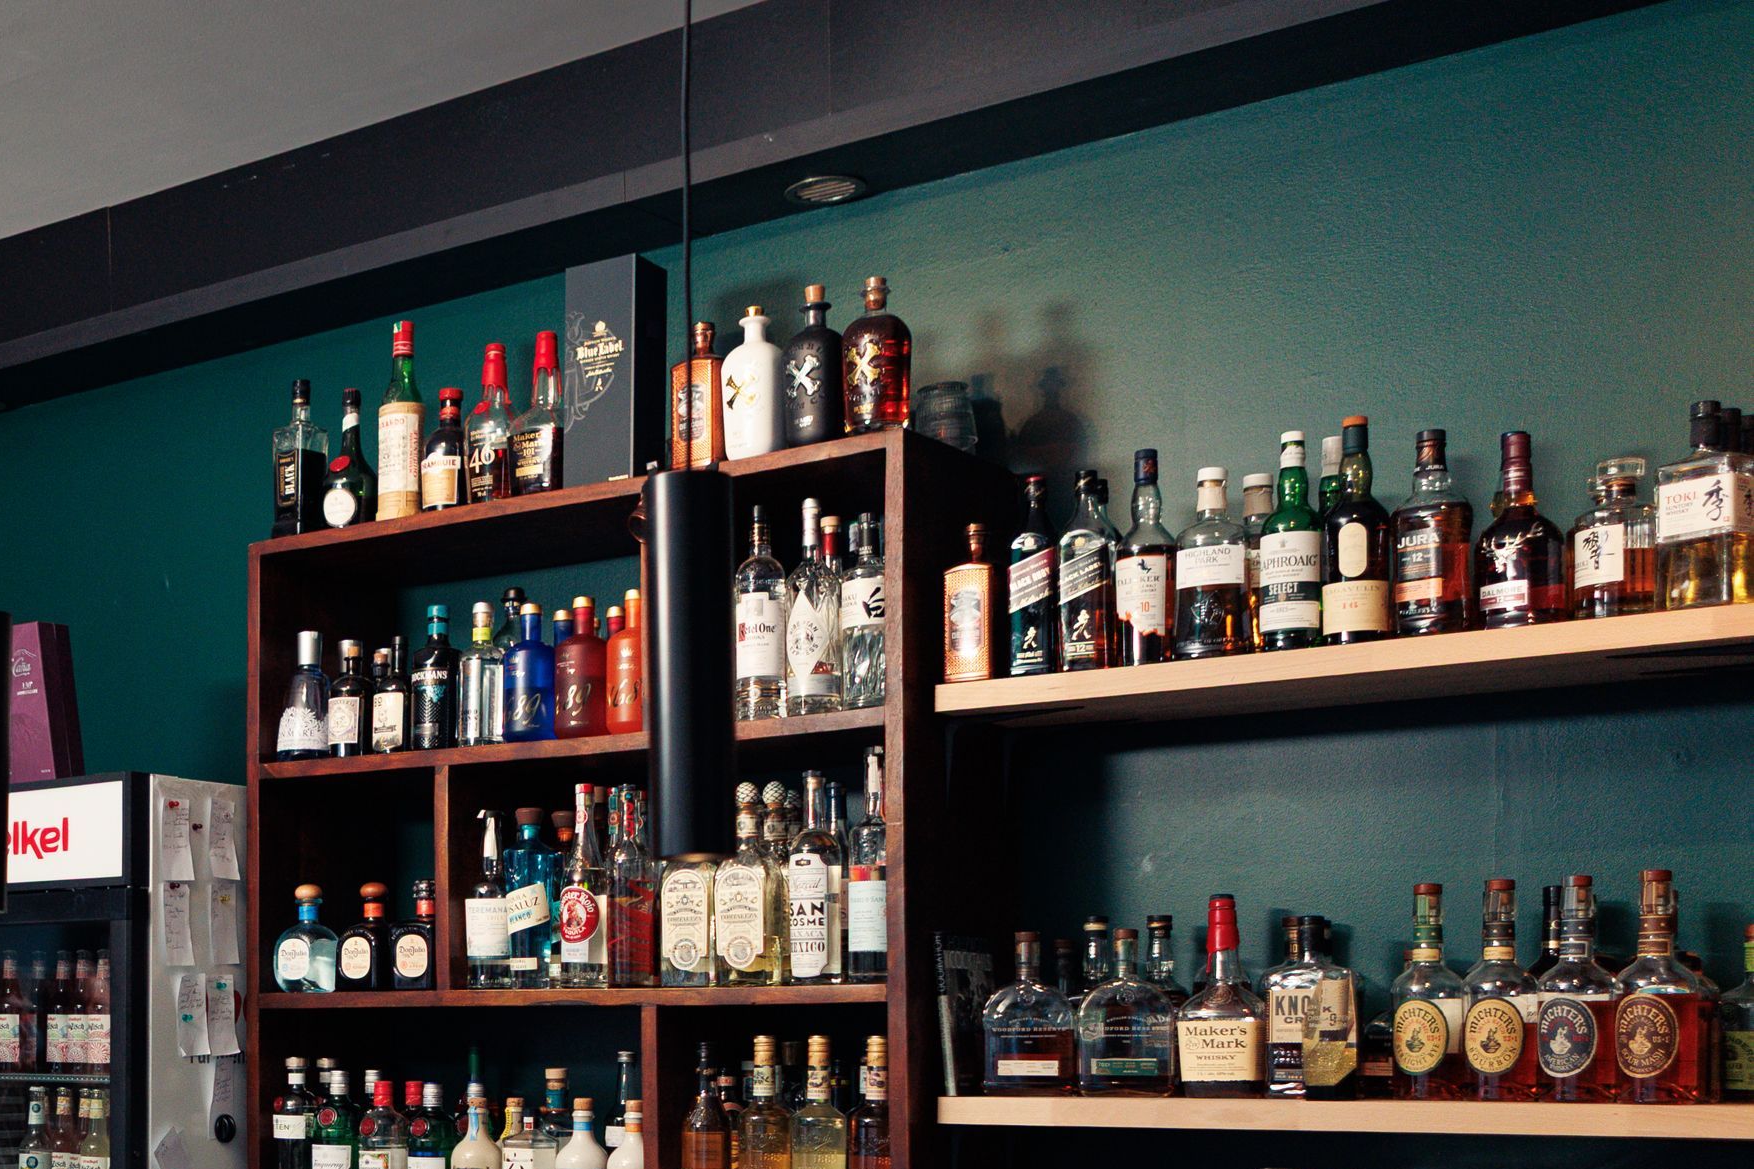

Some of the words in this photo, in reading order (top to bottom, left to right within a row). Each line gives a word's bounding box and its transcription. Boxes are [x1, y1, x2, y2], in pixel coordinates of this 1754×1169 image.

[576, 346, 598, 360] Blue
[598, 339, 624, 357] Label
[423, 459, 456, 469] RAMBUIE
[469, 441, 496, 474] 46
[284, 463, 295, 495] BLACK
[1665, 491, 1697, 505] TOKI
[1397, 532, 1440, 549] JURA
[1184, 547, 1231, 559] HIGHLAND
[1194, 556, 1219, 564] PARK
[1412, 552, 1423, 563] 12
[1268, 582, 1299, 595] SELECT
[1482, 585, 1523, 597] DALMORE
[1141, 601, 1150, 613] 10
[739, 623, 758, 642] Ketel
[759, 622, 776, 634] One
[7, 817, 69, 859] lkel
[789, 901, 825, 916] SAN
[562, 926, 587, 936] TEQUILA
[1275, 995, 1311, 1016] KNO
[1396, 1007, 1440, 1034] MICHTER'S
[1469, 1007, 1516, 1034] MICHTER'S
[1540, 1005, 1588, 1035] MICHTER'S
[1619, 1004, 1670, 1034] MICHTER'S
[1184, 1026, 1248, 1036] Maker's
[1201, 1038, 1248, 1049] Mark
[1469, 1045, 1517, 1067] BOURBON
[1543, 1053, 1580, 1067] AMERICAN
[1640, 1048, 1666, 1067] MASH
